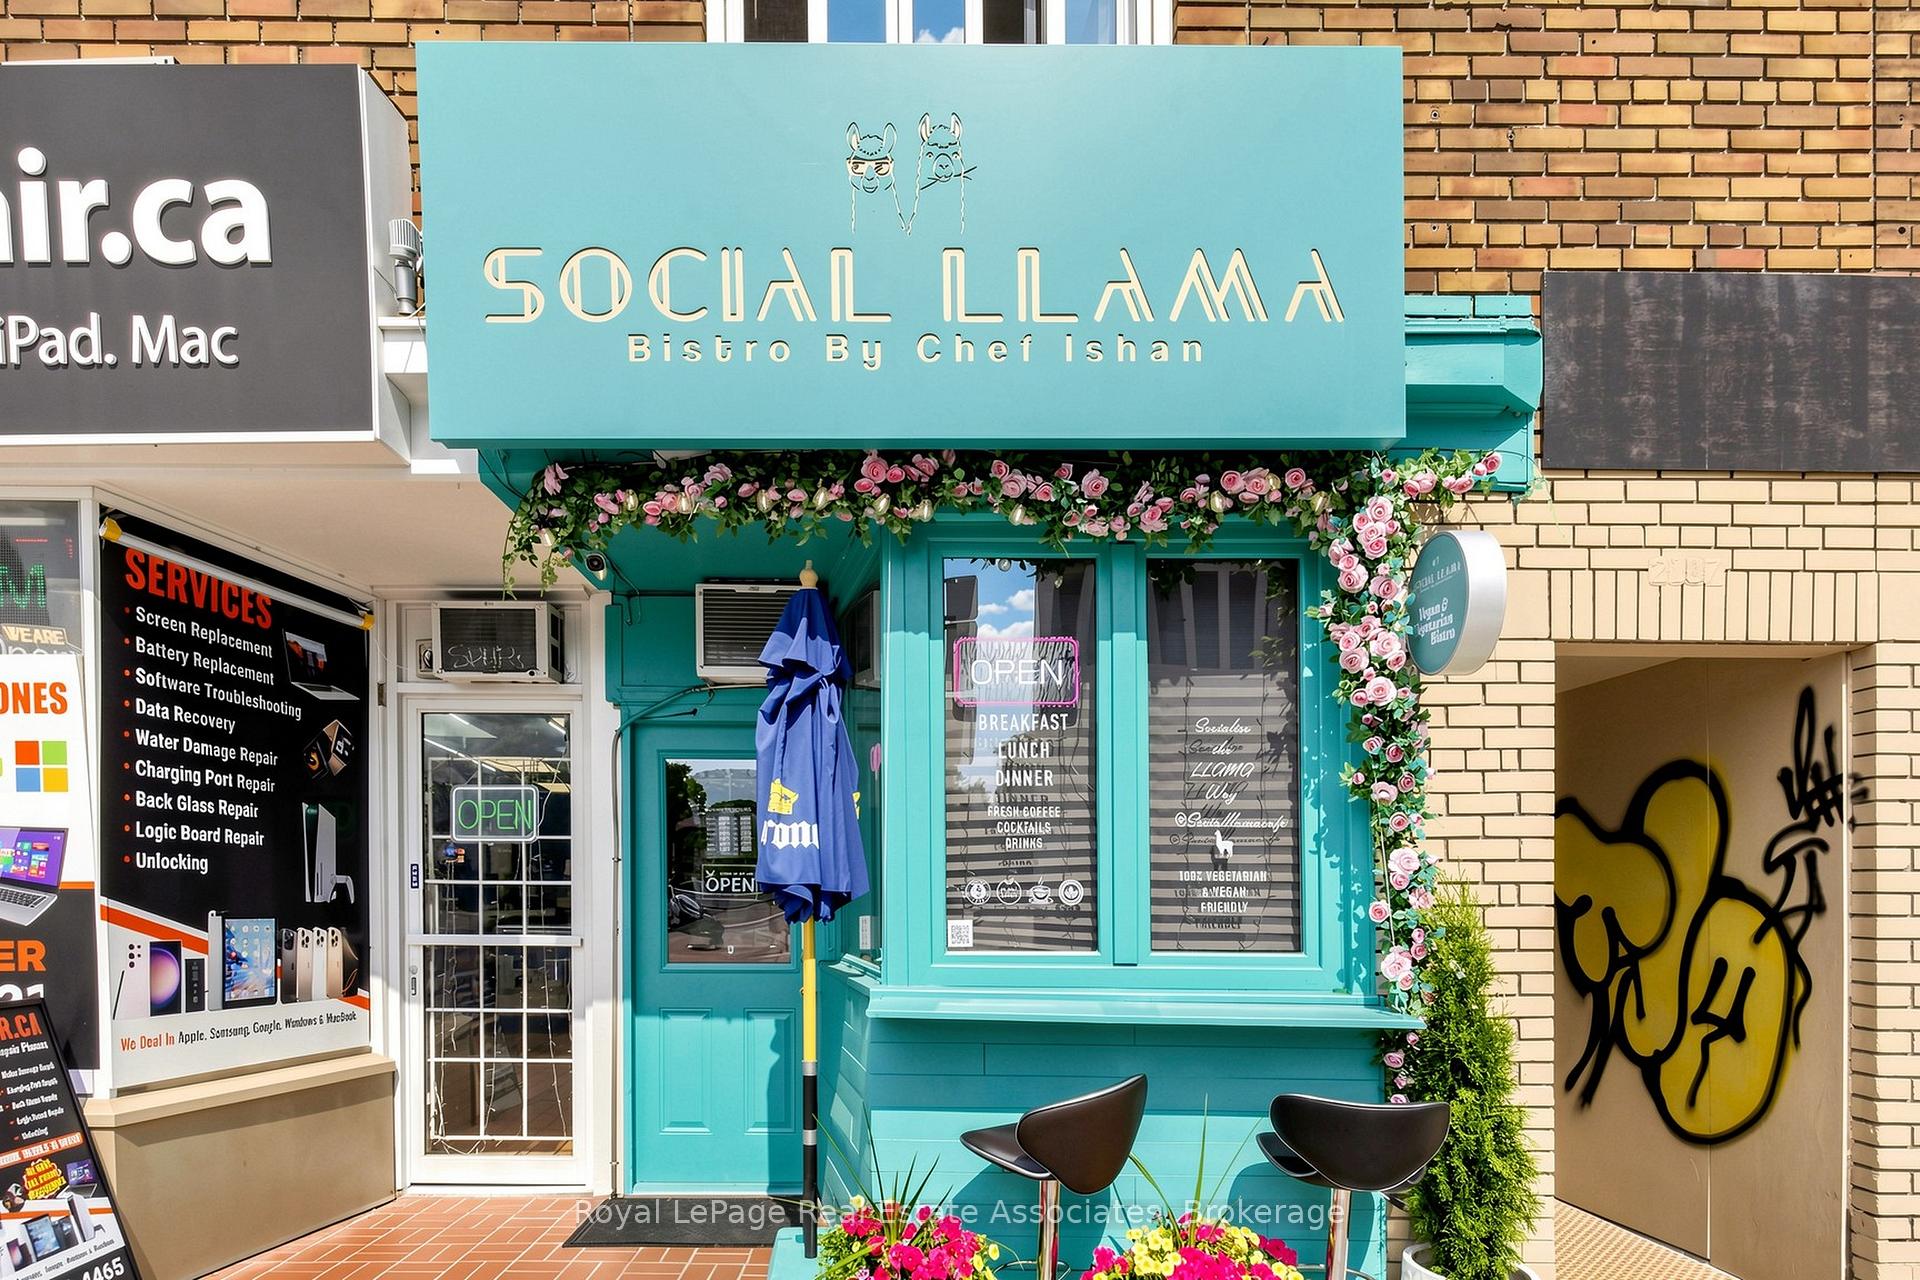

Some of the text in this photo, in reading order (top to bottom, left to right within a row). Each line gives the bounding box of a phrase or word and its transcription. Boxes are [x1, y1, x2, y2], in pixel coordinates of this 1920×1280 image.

[0, 147, 272, 267] ir.ca
[483, 246, 1345, 322] SOCIAL LLAMA
[131, 314, 240, 367] Mac
[628, 333, 1202, 371] Bistro By Chef Ishan
[124, 547, 272, 630] SERVICES
[135, 606, 273, 659] Screen Replacement
[135, 635, 274, 686] Battery Replacement
[971, 659, 1063, 686] OPEN
[135, 667, 302, 721] Software Troubleshooting
[135, 697, 236, 735] Data Recovery
[978, 713, 1069, 732] BREAKFAST
[1194, 716, 1252, 734] Socialise
[135, 728, 279, 768] Water Damage Repair
[998, 741, 1051, 759] LUNCH
[135, 759, 276, 794] Charging Port Repair
[995, 769, 1054, 787] DINNER
[135, 790, 259, 819] Back Glass Repair
[1204, 782, 1241, 805] Way
[458, 799, 533, 830] OPEN
[987, 806, 1062, 819] FRESH COFFEE
[135, 821, 265, 848] Logic Board Repair
[996, 821, 1052, 834] COCKTAILS
[1005, 837, 1044, 850] DRINKS
[135, 851, 209, 875] Unlocking
[1179, 870, 1268, 882] 100% VEGETARIAN
[705, 876, 755, 893] OPEN
[1213, 886, 1247, 898] VEGAN
[1200, 901, 1249, 913] FRIENDLY
[120, 1037, 137, 1052] We
[140, 1034, 162, 1049] Deal
[165, 1031, 176, 1046] In
